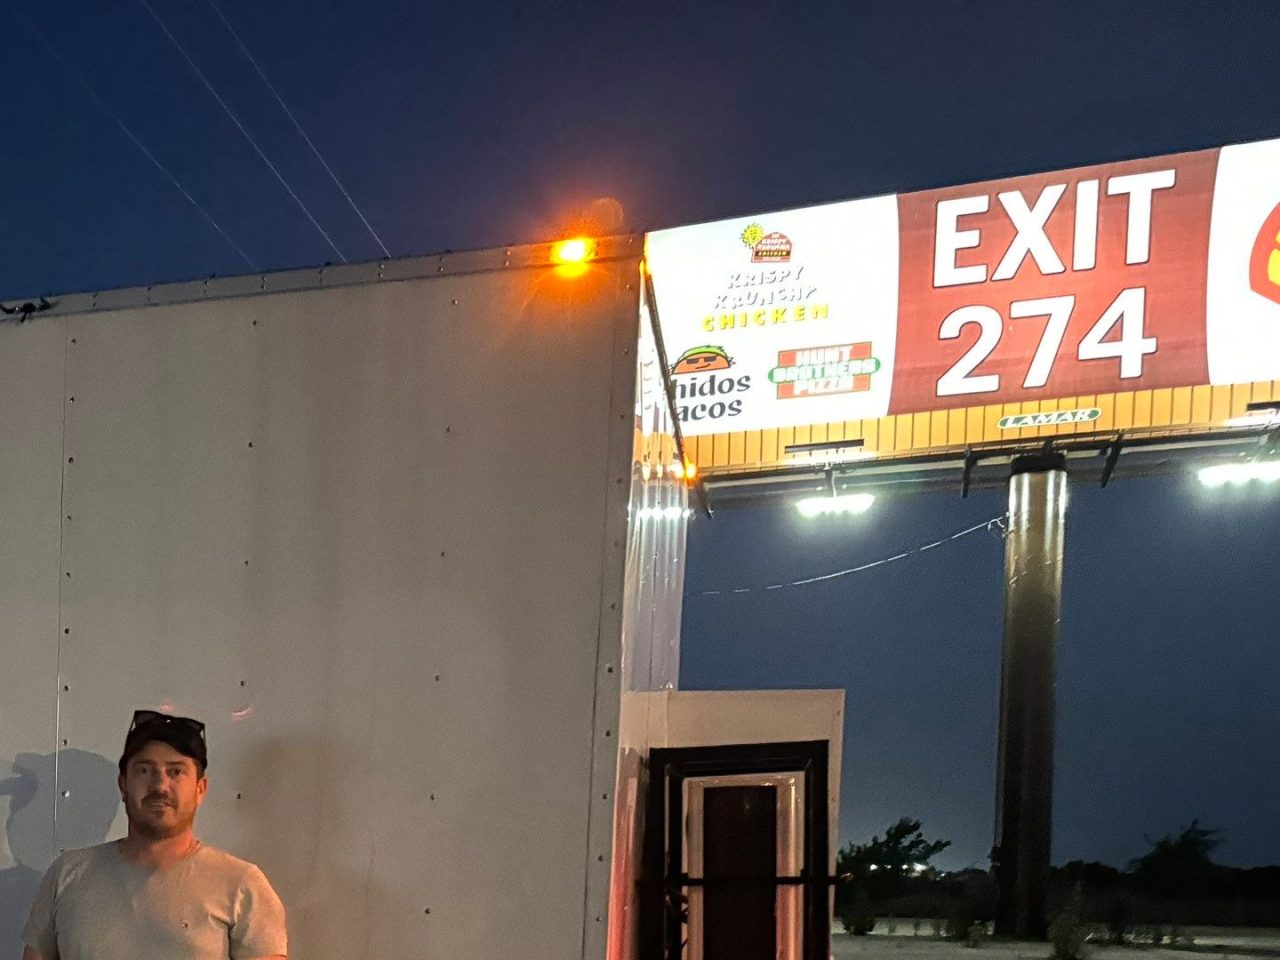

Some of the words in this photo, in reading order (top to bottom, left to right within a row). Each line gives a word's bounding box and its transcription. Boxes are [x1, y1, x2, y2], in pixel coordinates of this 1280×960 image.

[932, 168, 1177, 288] EXIT
[727, 265, 805, 290] KRISPY
[713, 284, 819, 311] KRUNCHY
[701, 303, 830, 333] CHICKEN
[935, 287, 1158, 398] 274
[672, 374, 752, 401] hidos
[675, 398, 743, 424] acos
[1005, 409, 1091, 427] LAMAR
